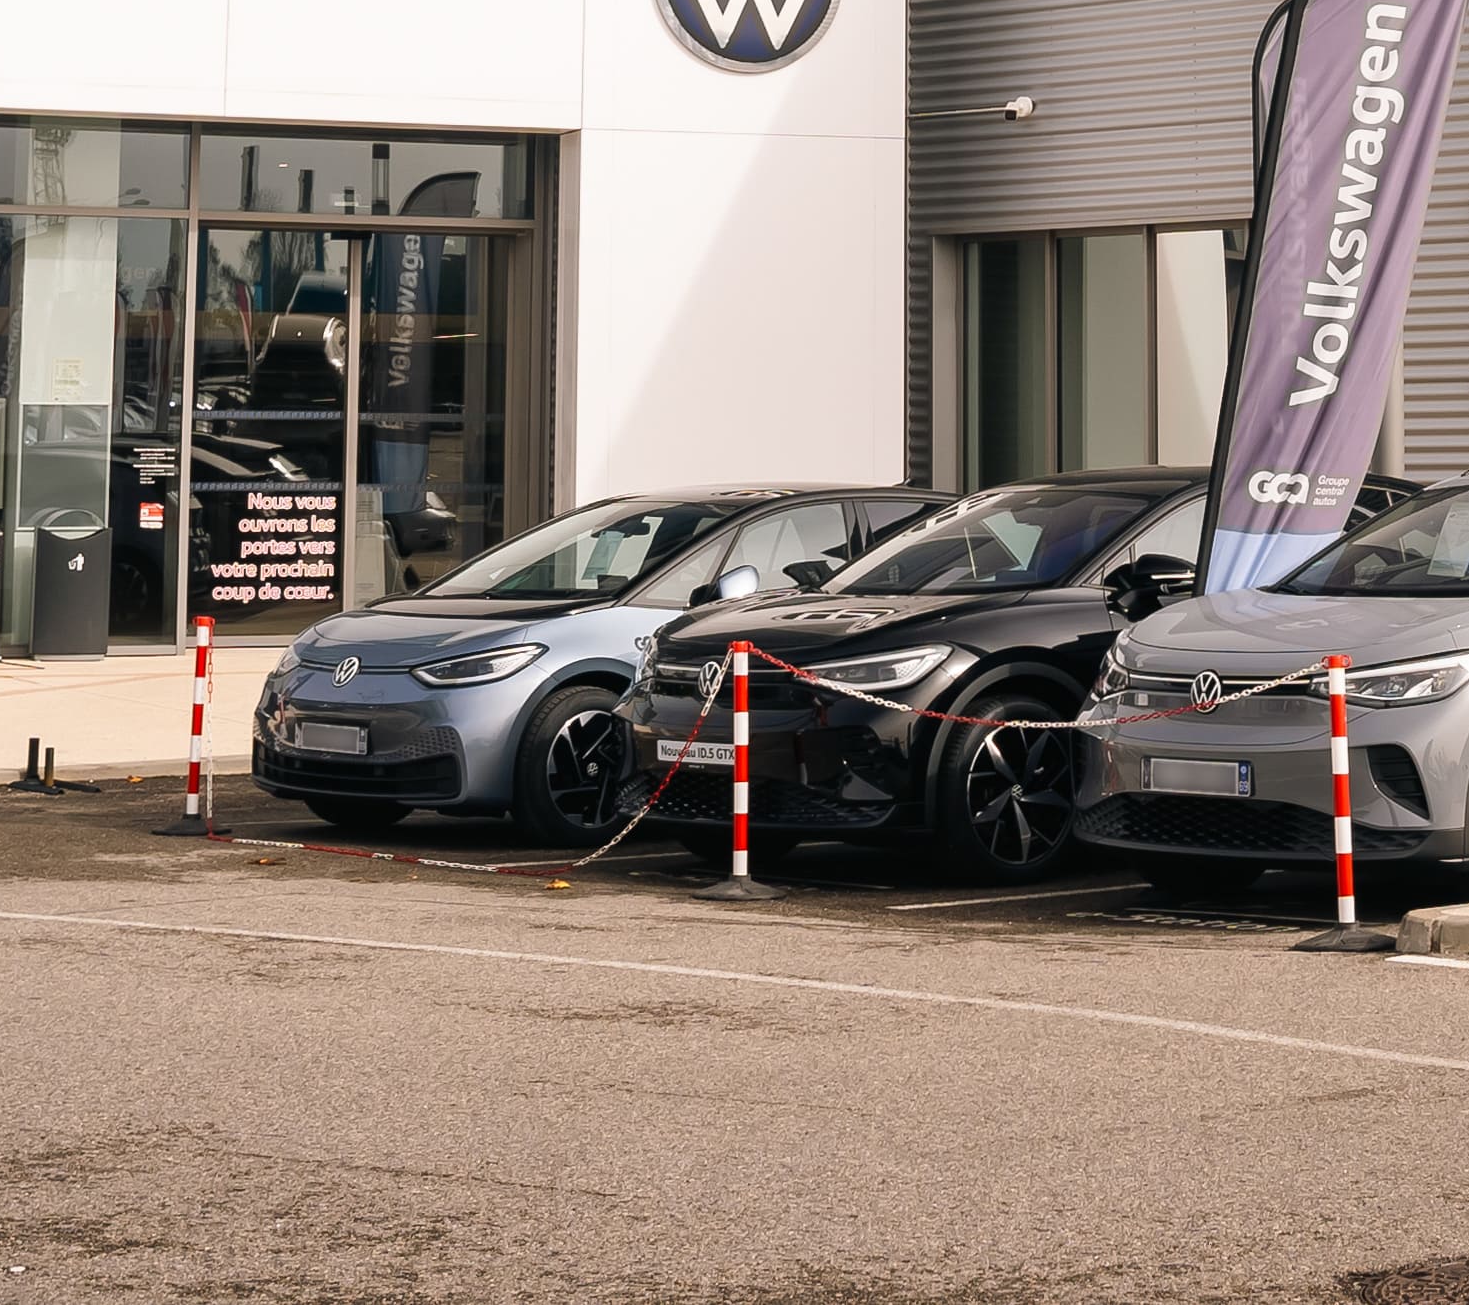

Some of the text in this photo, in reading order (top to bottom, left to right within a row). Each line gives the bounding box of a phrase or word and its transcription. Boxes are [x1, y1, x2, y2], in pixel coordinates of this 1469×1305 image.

[1288, 2, 1407, 407] Volkswagen
[387, 233, 424, 387] Volkswage
[247, 492, 337, 510] Nous vous
[238, 514, 336, 533] ouvrons les
[240, 539, 336, 558] portes vers
[210, 559, 334, 581] votre prochain
[211, 582, 334, 604] coup de cœur.
[660, 744, 735, 760] Nouvau ID.5 GTX
